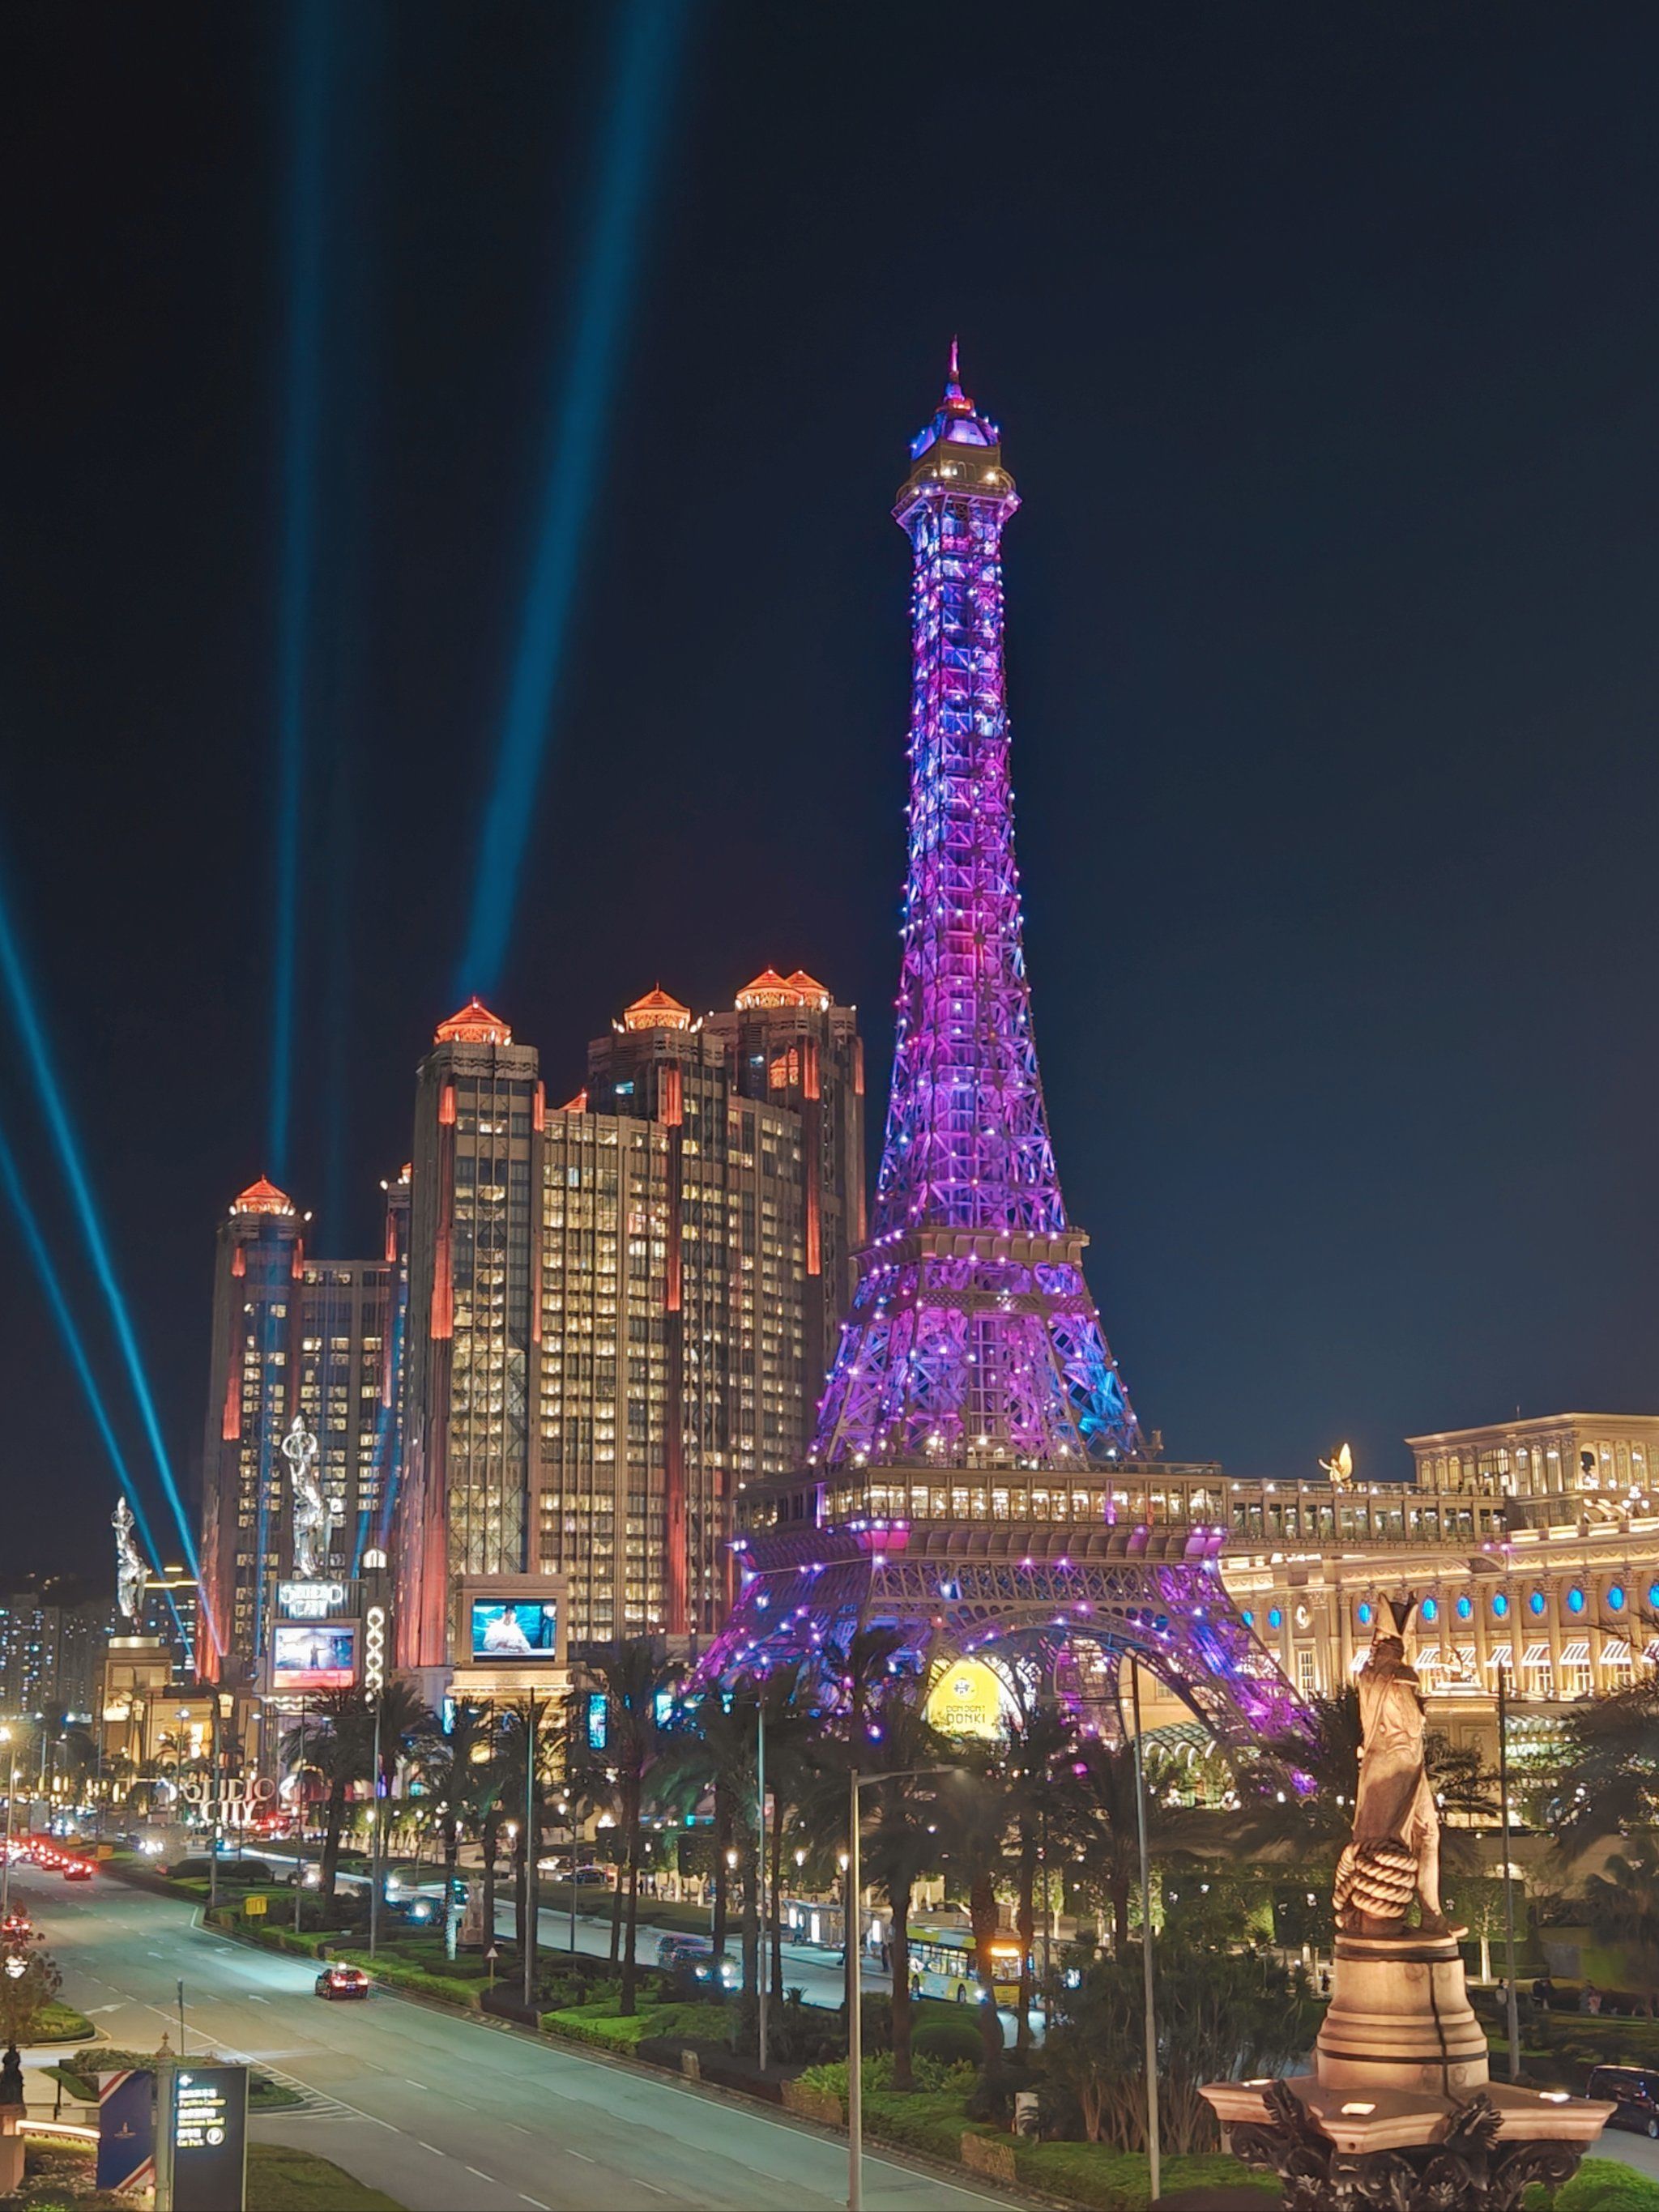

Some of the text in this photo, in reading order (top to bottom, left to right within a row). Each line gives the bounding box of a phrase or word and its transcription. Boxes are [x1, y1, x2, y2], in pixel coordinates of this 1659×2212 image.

[946, 1713, 985, 1724] DONKI
[183, 1778, 275, 1803] STUDIO
[201, 1800, 258, 1825] CITY
